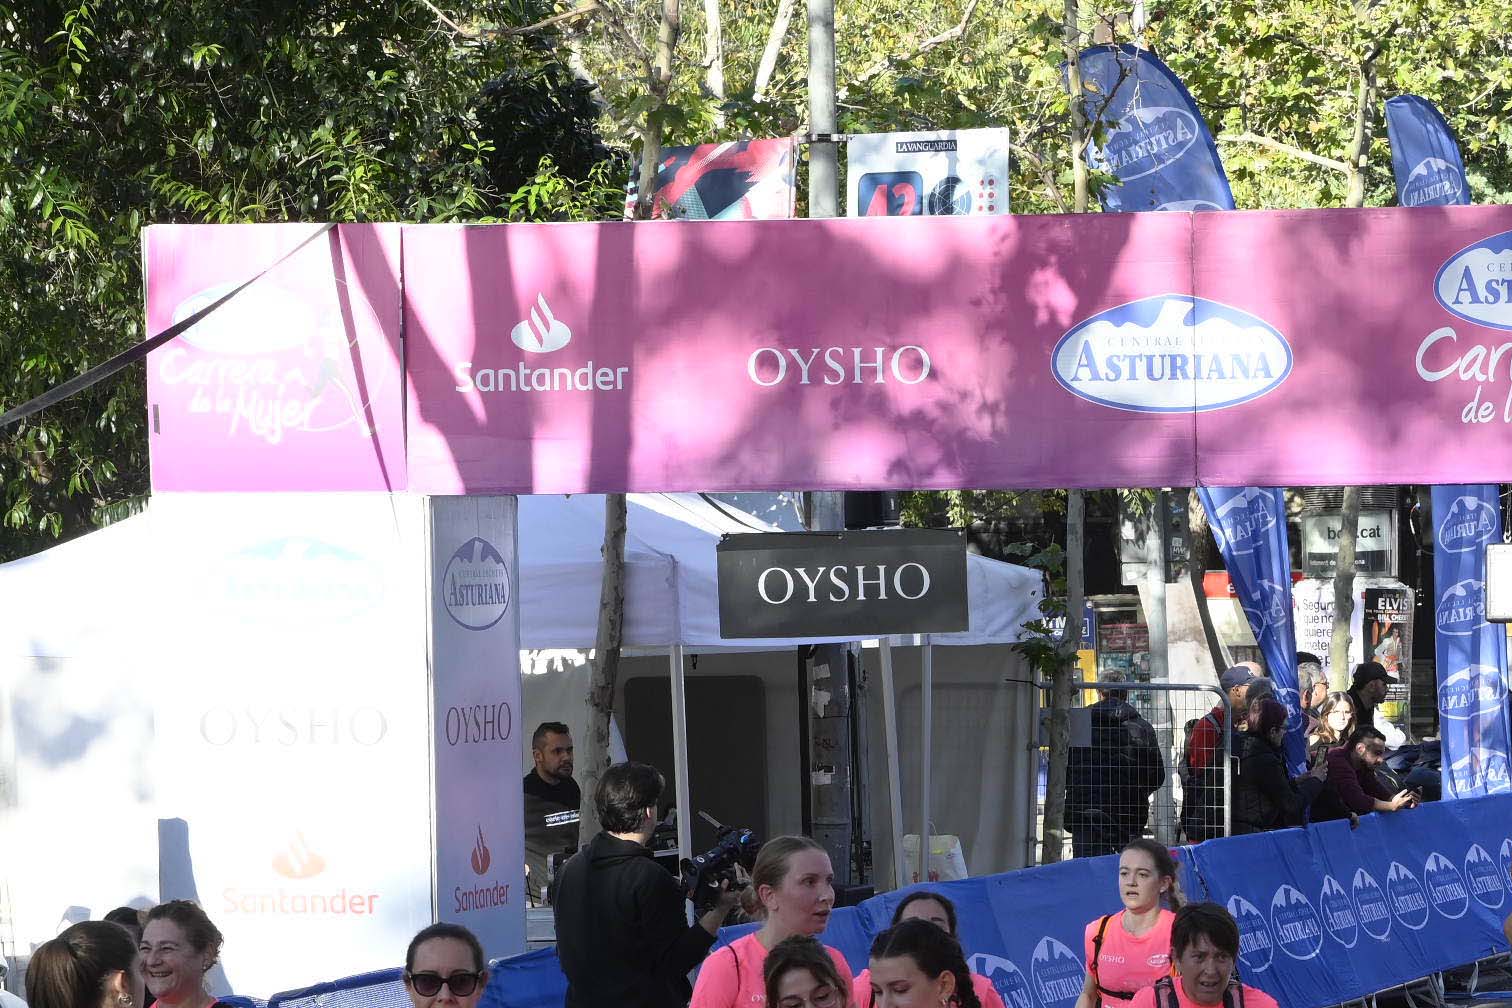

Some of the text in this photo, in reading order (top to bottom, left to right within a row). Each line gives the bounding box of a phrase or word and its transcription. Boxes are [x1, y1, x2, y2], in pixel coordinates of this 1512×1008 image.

[1106, 335, 1182, 347] CENTRAL
[454, 360, 629, 393] Santander
[747, 344, 931, 387] OYSHO
[1070, 339, 1274, 382] ASTURIANA
[1461, 384, 1496, 424] de
[448, 571, 506, 607] ASTURIANA
[757, 562, 932, 606] OYSHO
[199, 705, 389, 748] OYSHO
[445, 702, 512, 747] OYSHO
[223, 887, 380, 917] Santander
[453, 880, 511, 915] Santander
[1429, 877, 1467, 904] ASTURIANA
[1275, 916, 1321, 945] ASTURIANA
